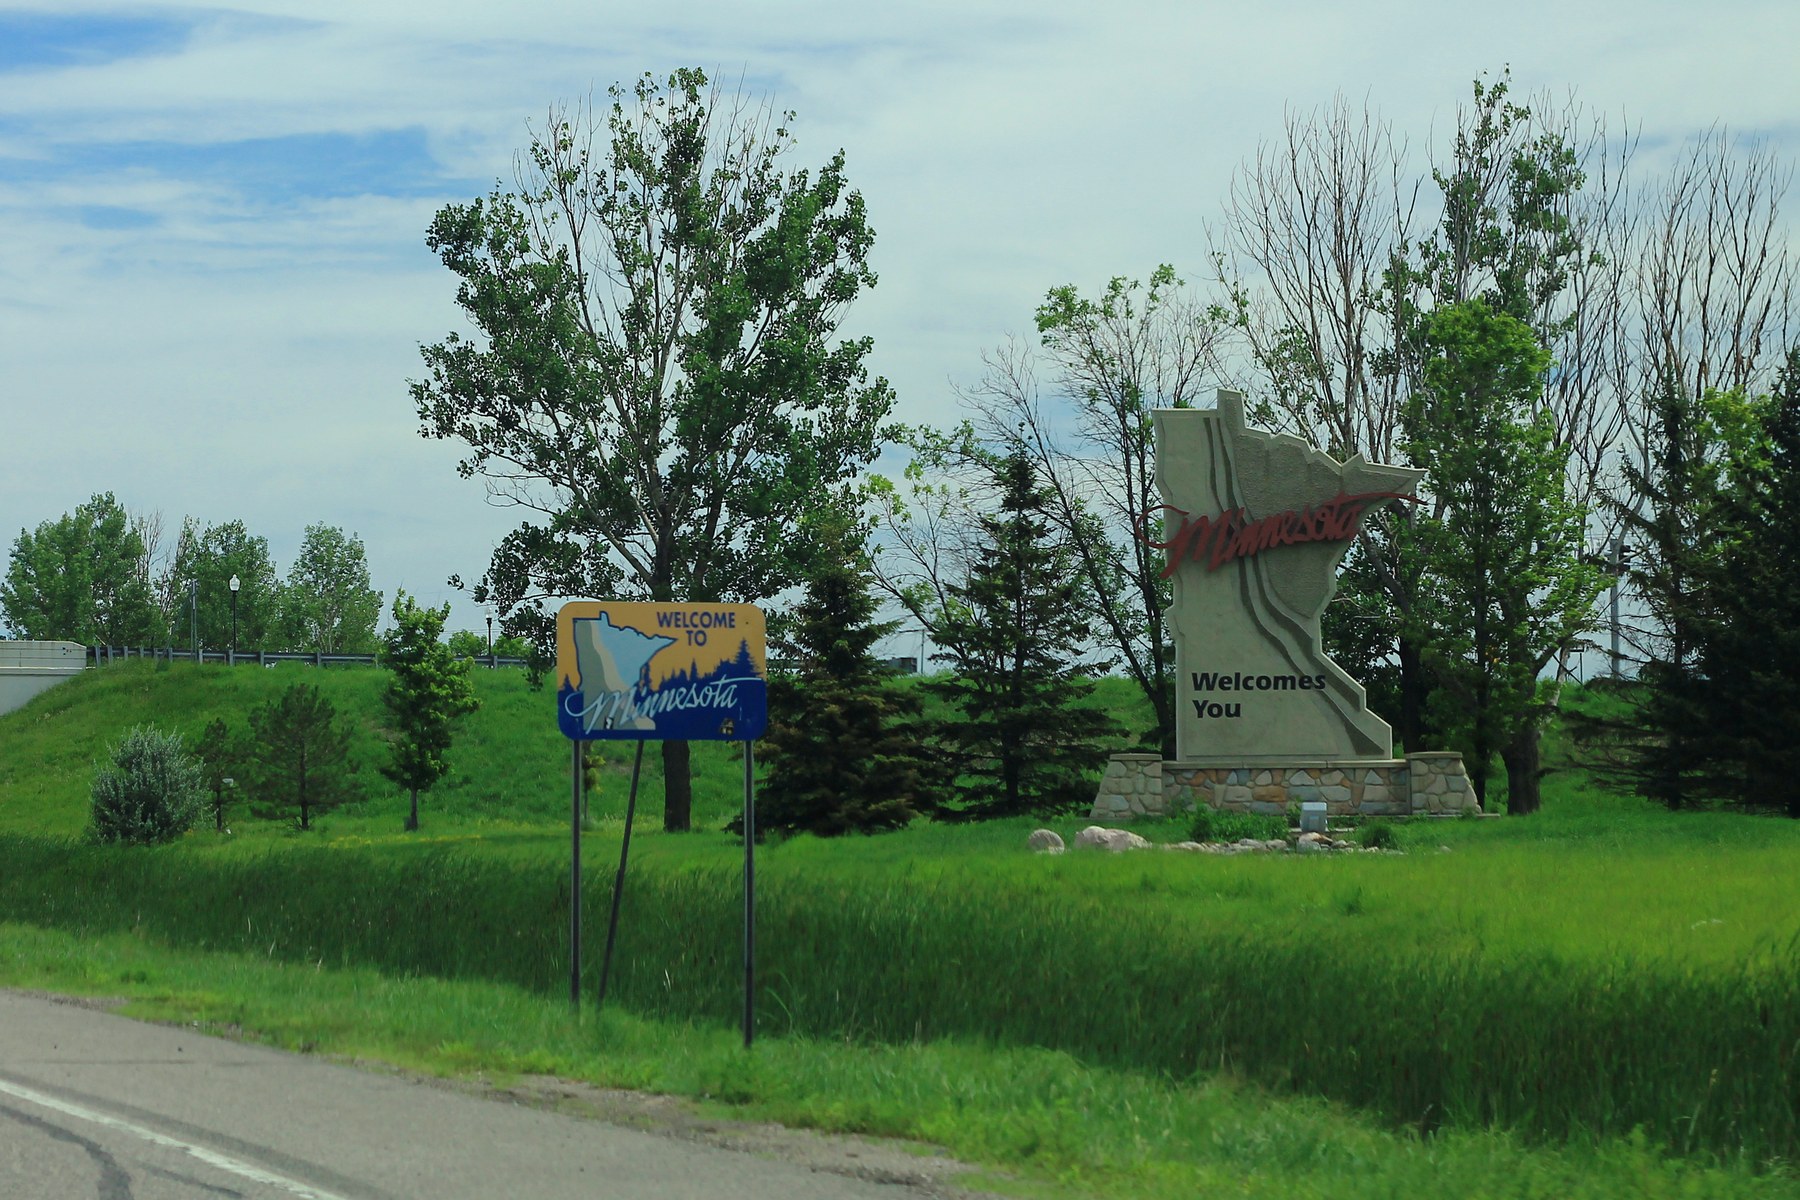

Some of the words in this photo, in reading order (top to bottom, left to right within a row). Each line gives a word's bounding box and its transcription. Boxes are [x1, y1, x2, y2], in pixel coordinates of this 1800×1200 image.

[1136, 493, 1428, 578] Minnesota
[656, 611, 736, 629] WELCOME
[686, 630, 707, 647] TO
[1191, 672, 1326, 692] Welcomes
[564, 674, 763, 735] Minnesota
[1193, 699, 1242, 719] You
